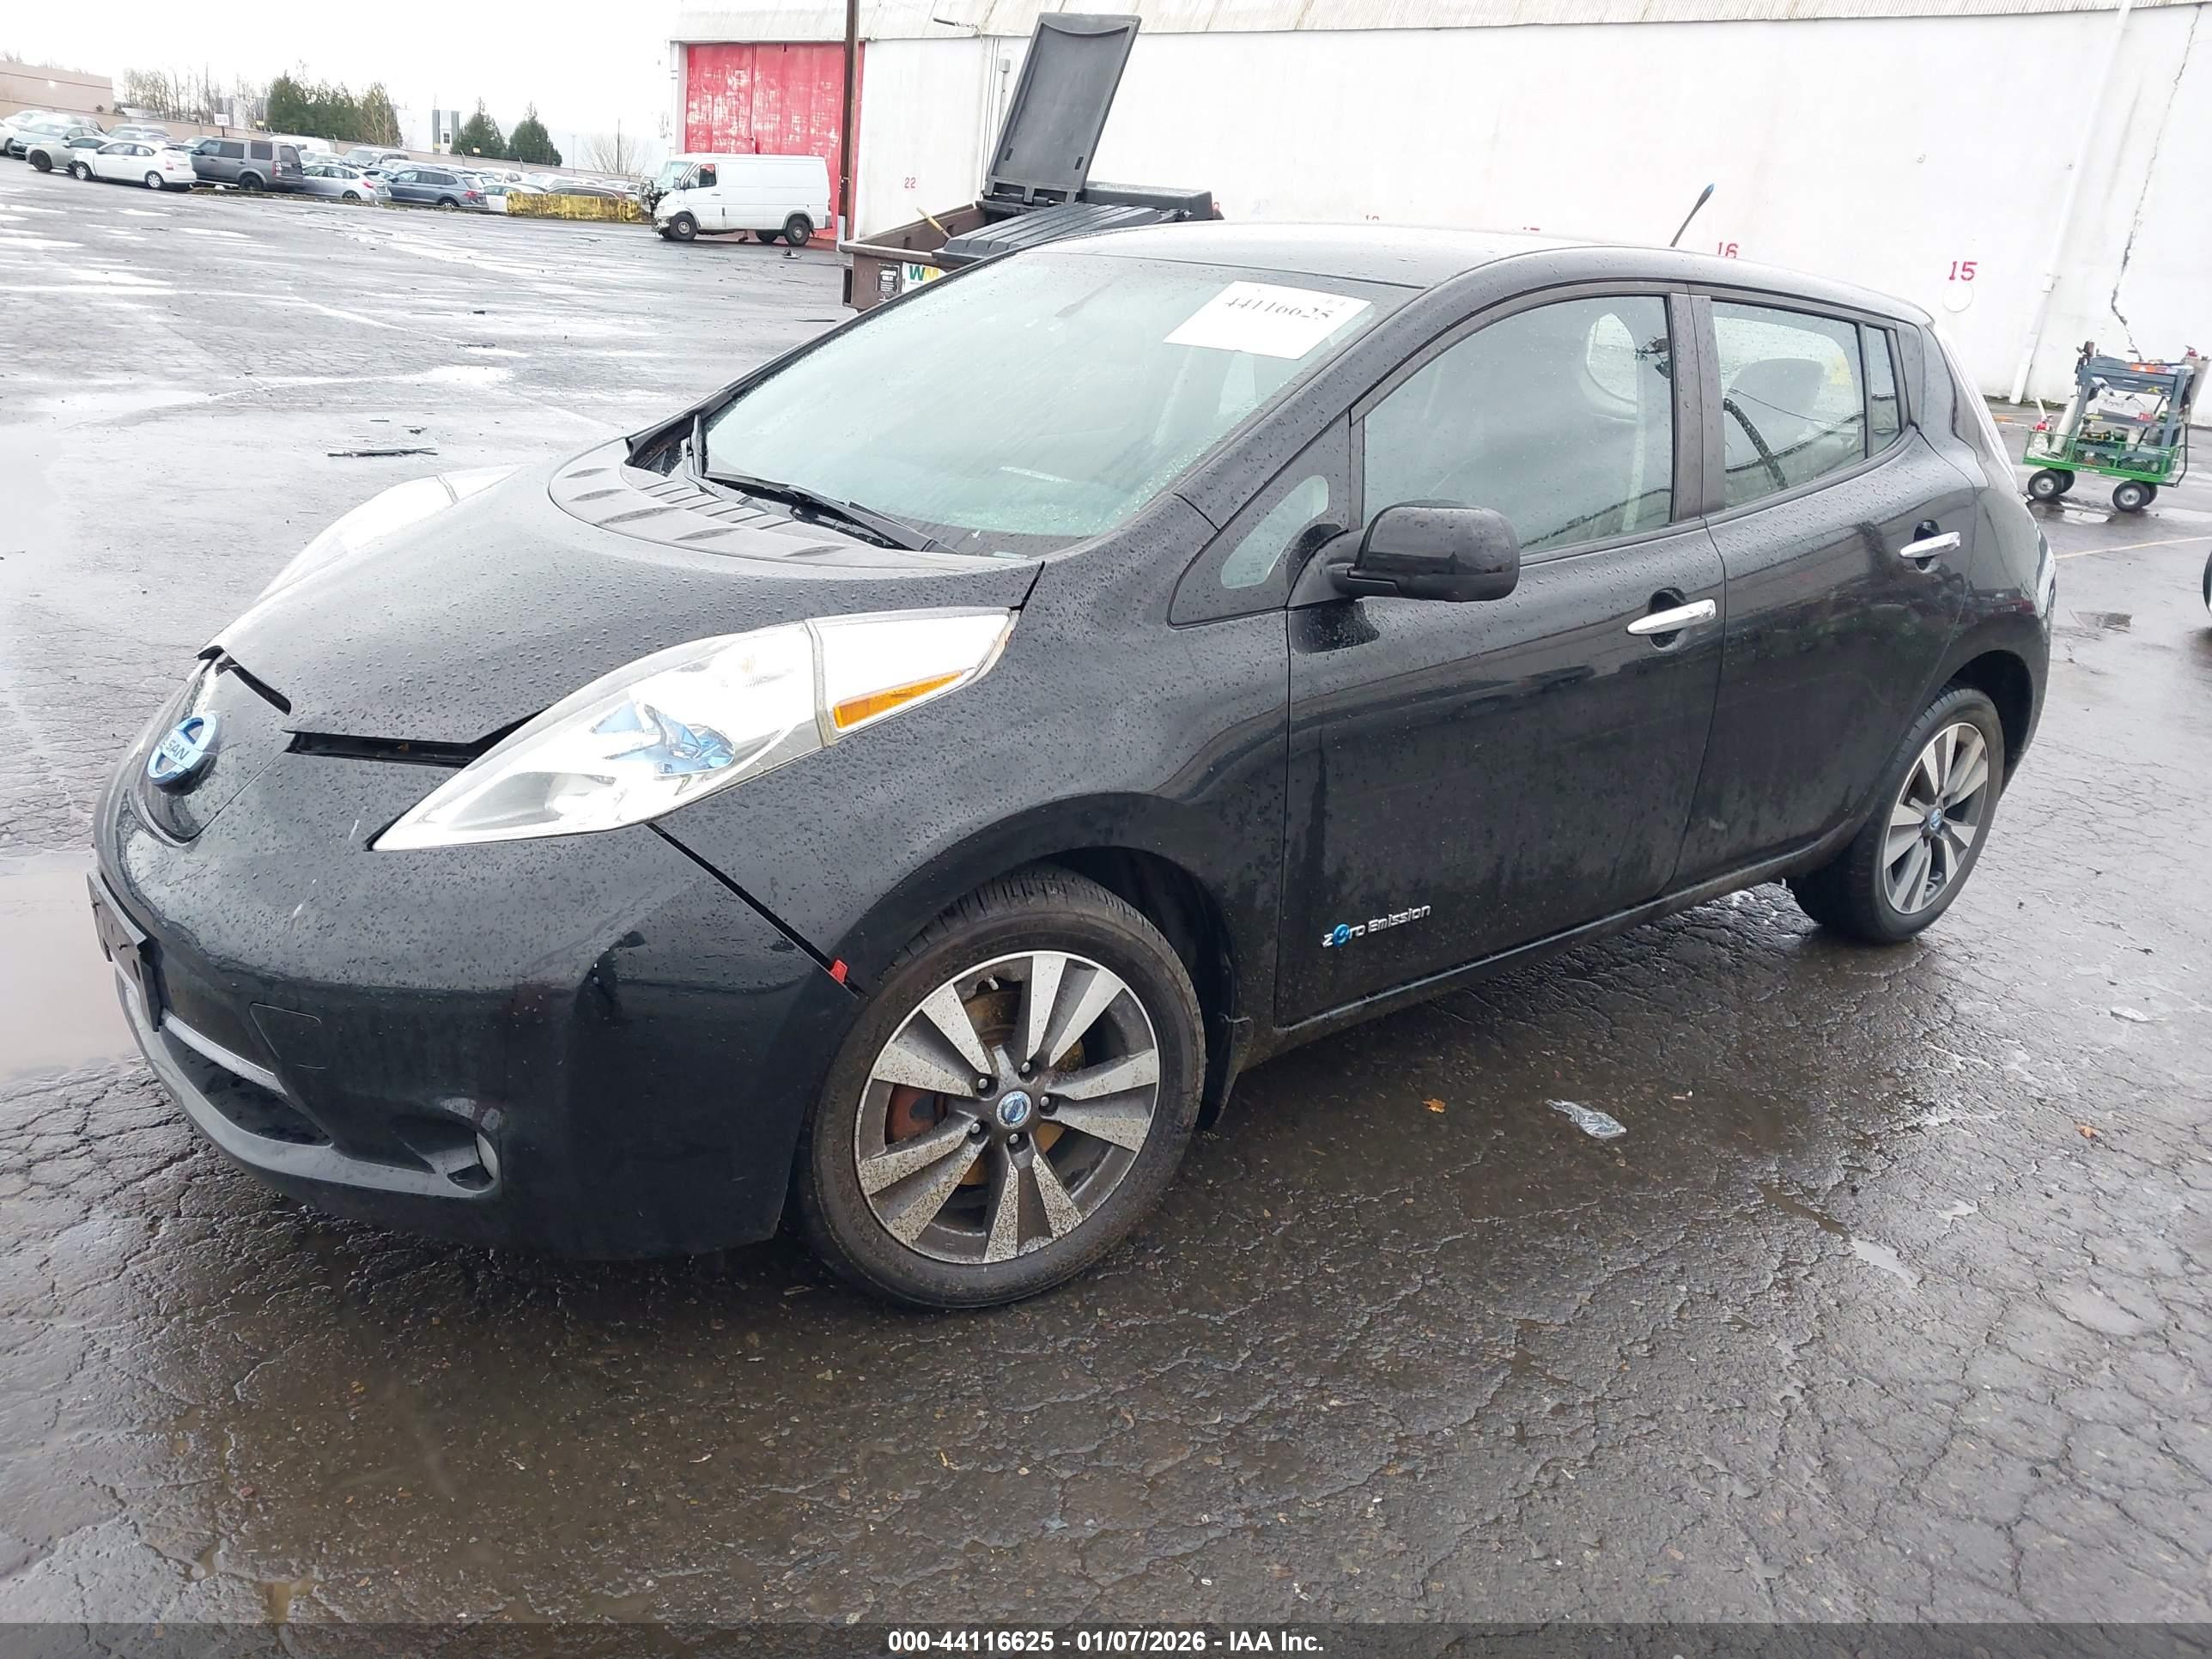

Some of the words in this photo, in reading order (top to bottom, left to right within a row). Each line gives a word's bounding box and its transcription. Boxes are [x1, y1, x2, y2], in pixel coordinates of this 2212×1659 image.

[903, 176, 917, 189] 22
[1717, 240, 1740, 259] 16
[908, 264, 940, 283] WM
[1948, 260, 1978, 282] 15
[1368, 905, 1431, 933] Emission
